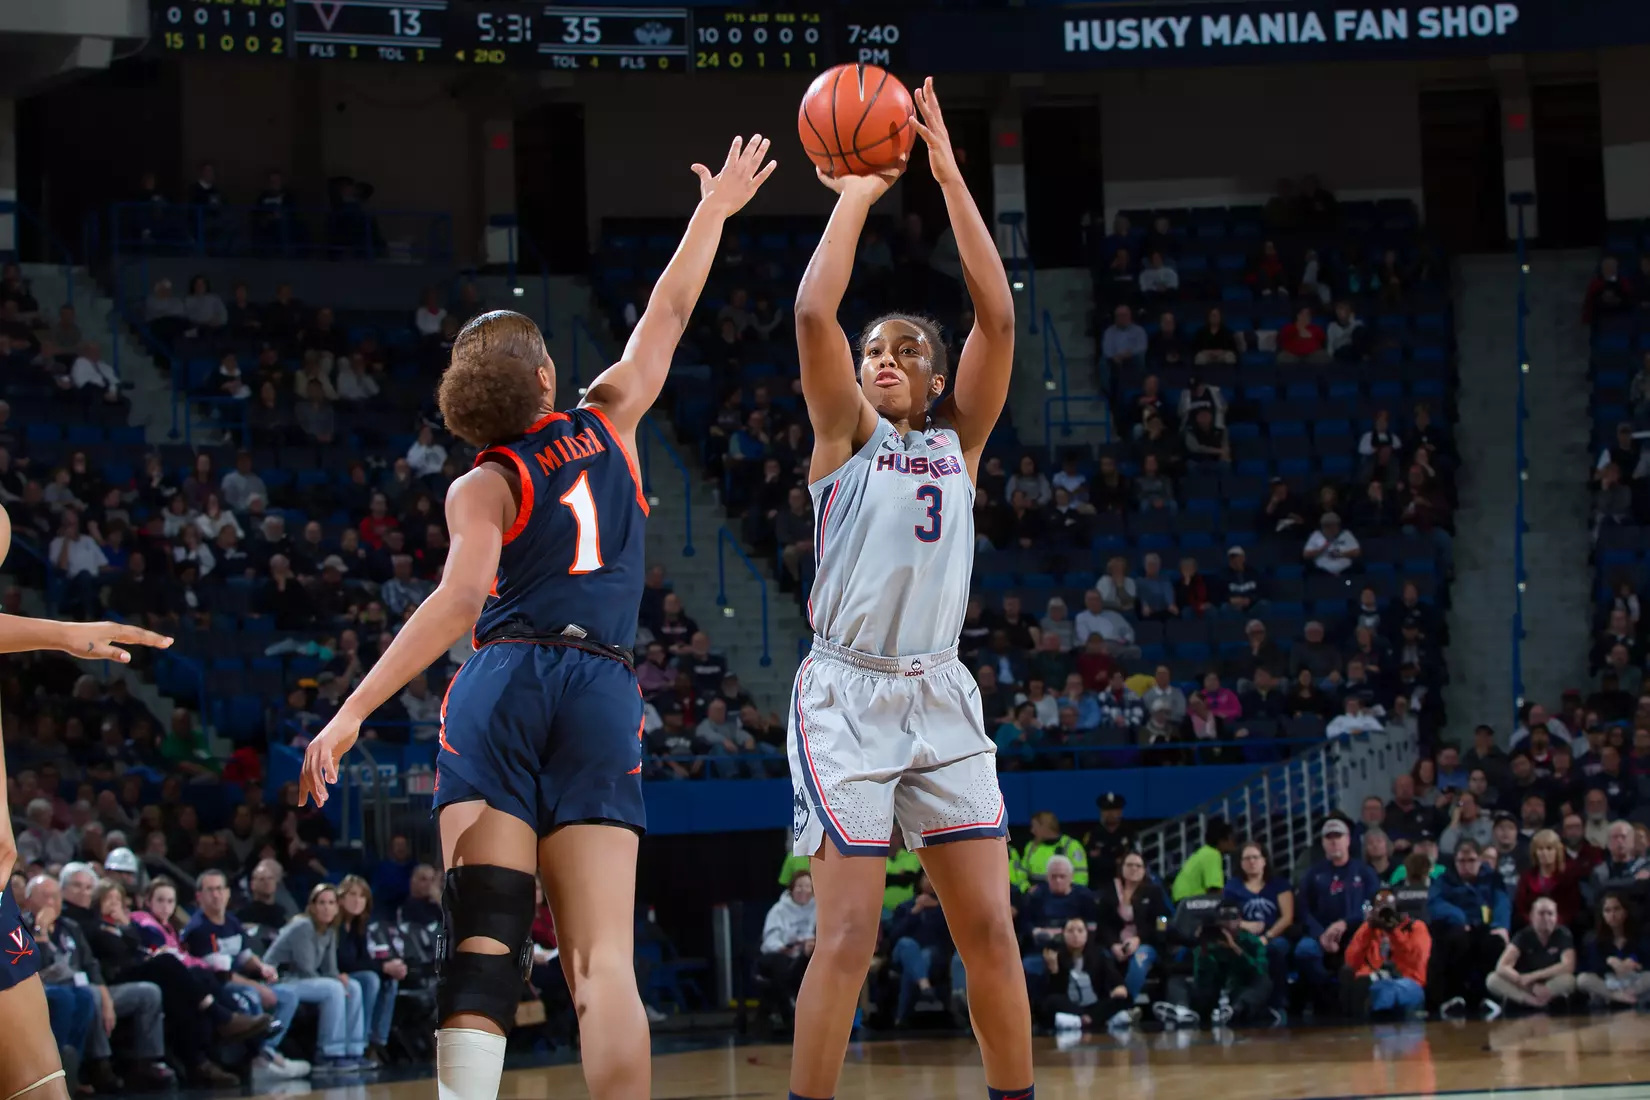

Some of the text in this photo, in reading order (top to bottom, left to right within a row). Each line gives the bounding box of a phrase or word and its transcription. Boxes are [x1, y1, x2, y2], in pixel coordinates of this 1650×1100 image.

[167, 6, 284, 28] 0 0 1 1 0
[389, 8, 423, 37] 13
[477, 12, 533, 43] 5:31
[1064, 3, 1519, 51] HUSKY MANIA FAN SHOP
[561, 16, 602, 44] 35
[697, 27, 819, 44] 10 0 0 0 0
[847, 24, 900, 44] 7:40
[165, 32, 283, 54] 15 1 0 0 2
[309, 43, 336, 58] FLS
[377, 46, 405, 62] TOL
[473, 48, 506, 64] 2ND
[551, 55, 669, 70] TOL 4 FLS 0
[696, 52, 817, 69] 24 0 1 1 1
[859, 49, 890, 64] PM
[876, 453, 962, 480] HUSIES
[559, 470, 605, 575] 1
[914, 484, 943, 543] 3
